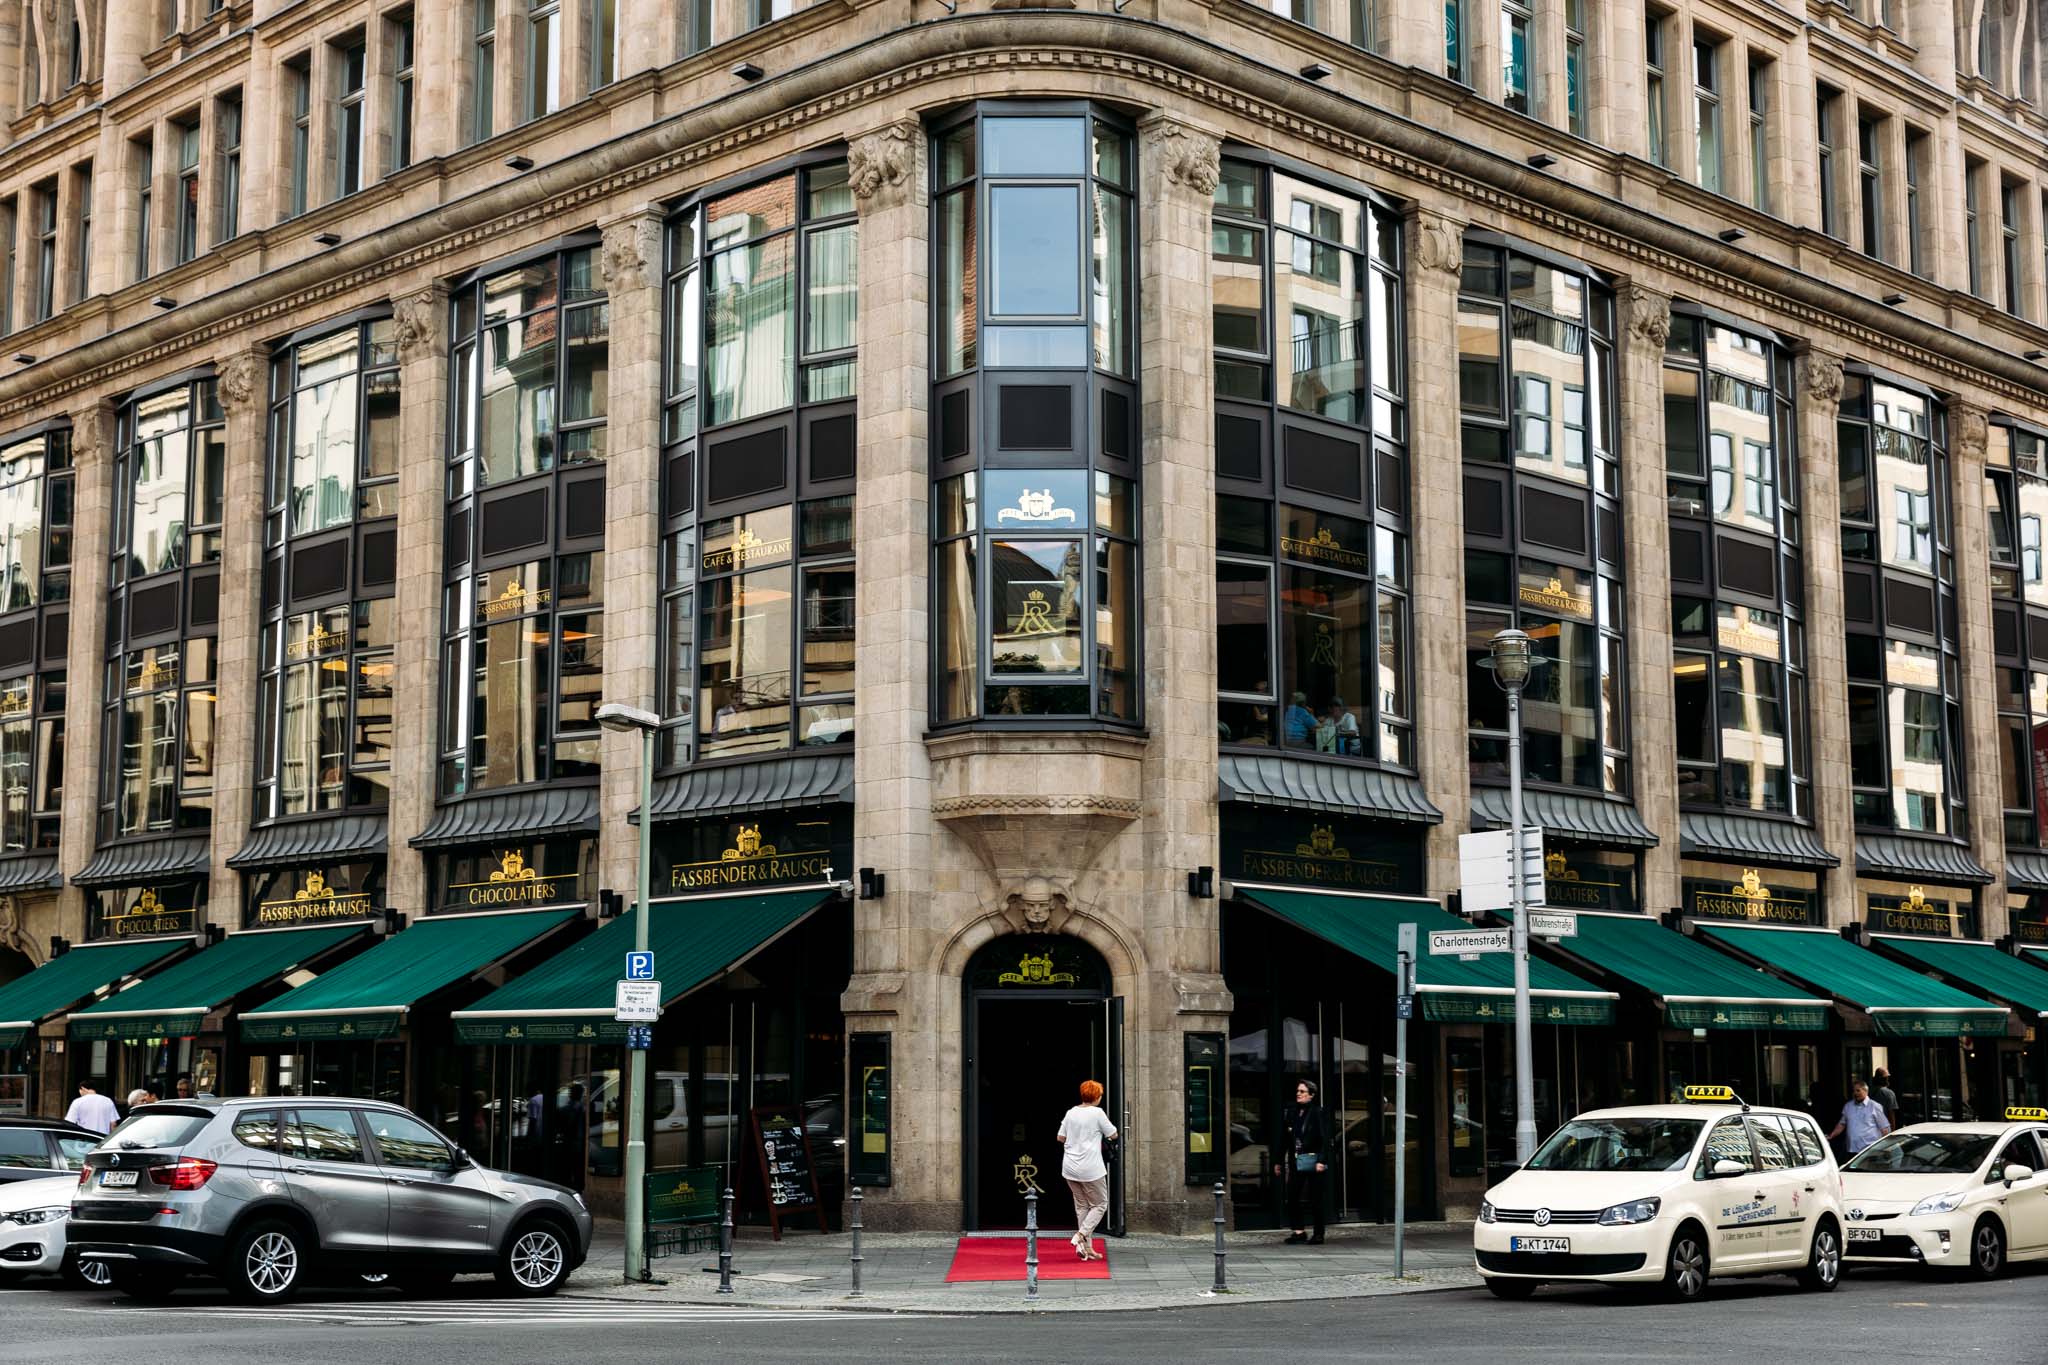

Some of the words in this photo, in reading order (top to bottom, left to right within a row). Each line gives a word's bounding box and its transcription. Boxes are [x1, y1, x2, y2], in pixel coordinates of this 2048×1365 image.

[726, 554, 733, 564] &
[734, 541, 790, 562] RESTAURANT
[1313, 546, 1367, 567] RESTAURANT
[671, 864, 757, 888] FASSBENDER
[758, 867, 767, 880] &
[770, 858, 830, 879] RAUSCH
[1243, 854, 1334, 881] FASSBENDER
[1344, 863, 1399, 886] RAUSCH
[469, 883, 556, 905] CHOCOLATIERS
[260, 903, 320, 921] FASSBENDER
[321, 904, 328, 916] &
[328, 899, 371, 916] RAUSCH
[1696, 895, 1759, 917] FASSBENDER
[1759, 904, 1766, 917] &
[1767, 902, 1807, 920] RAUSCH
[116, 917, 180, 934] CHOCOLATIERS
[1531, 916, 1573, 931] Mohrenstraße
[1886, 912, 1950, 932] CHOCOLATIERS
[1433, 933, 1507, 948] Charlottenstraße
[632, 955, 648, 977] P
[1691, 1087, 1721, 1096] TAXI
[2011, 1108, 2037, 1116] TAXI
[1528, 1240, 1540, 1250] KT
[1543, 1239, 1567, 1250] 1744
[1848, 1230, 1860, 1239] BF
[1861, 1230, 1877, 1239] 940
